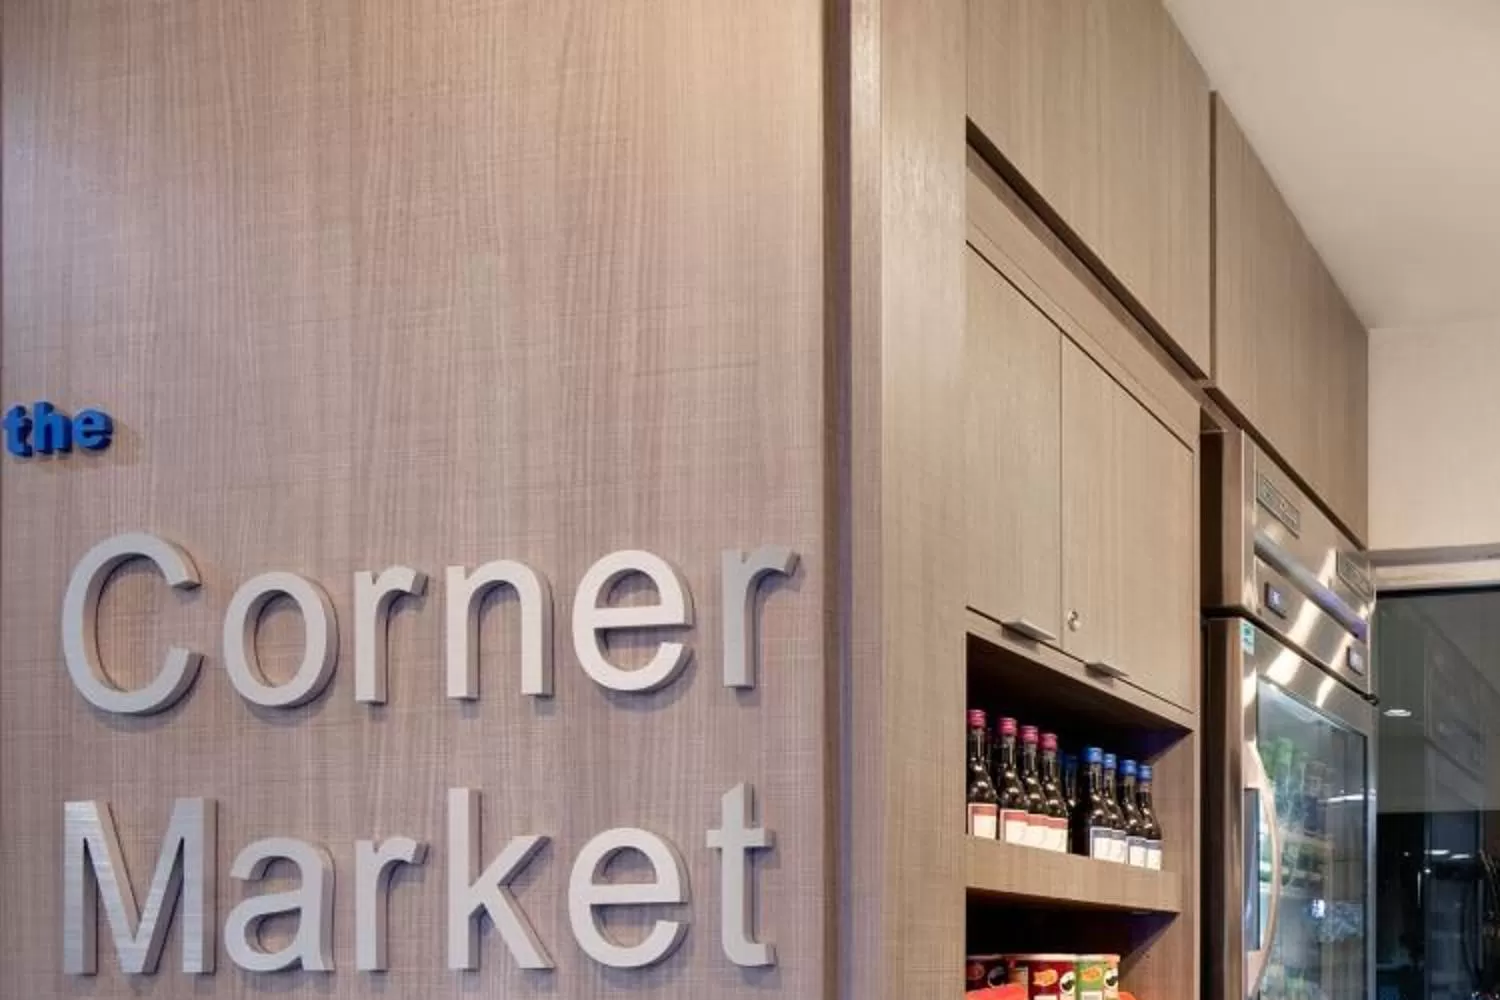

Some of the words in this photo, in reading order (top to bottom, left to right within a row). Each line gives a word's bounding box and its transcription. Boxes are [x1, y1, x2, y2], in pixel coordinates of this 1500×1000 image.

[2, 402, 113, 457] the
[61, 532, 801, 716] Corner
[62, 781, 777, 976] Market
